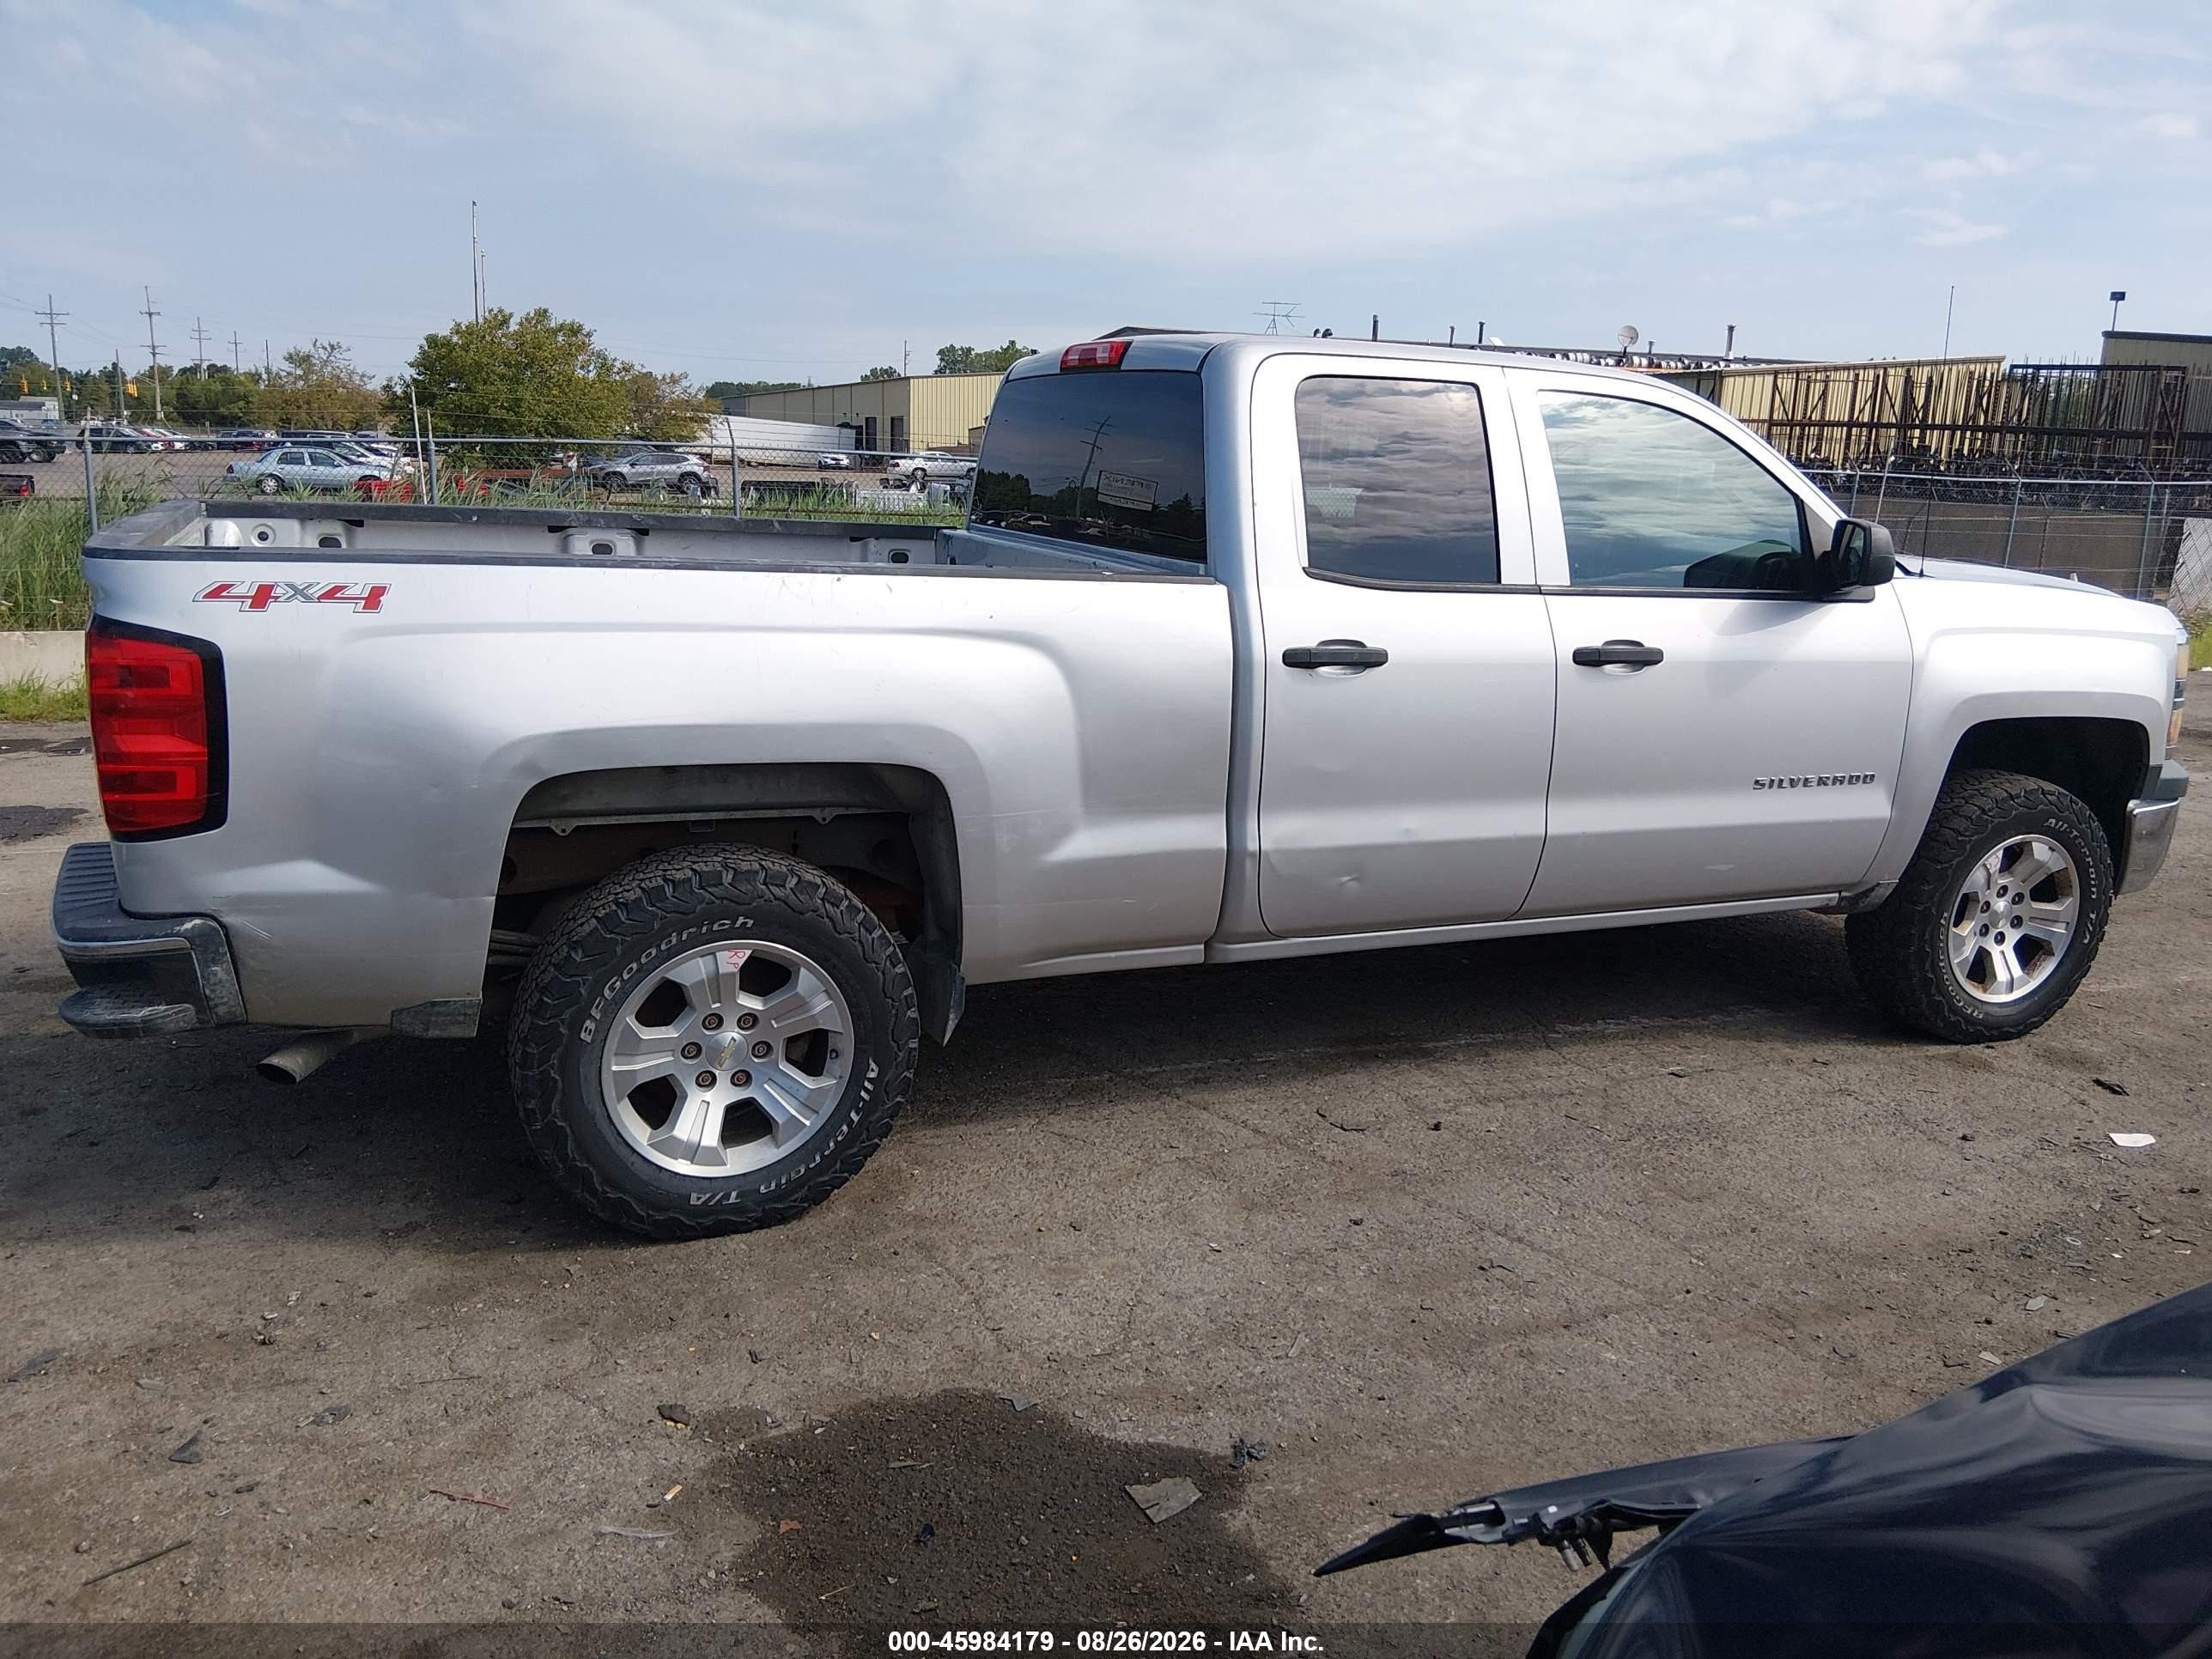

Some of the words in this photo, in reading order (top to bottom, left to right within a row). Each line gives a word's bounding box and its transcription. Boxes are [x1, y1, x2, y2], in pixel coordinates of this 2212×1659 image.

[1753, 773, 1875, 790] SILVERADO
[580, 916, 754, 1043] BFGoodrich
[760, 1058, 879, 1194] All-Terrain
[690, 1190, 741, 1206] T/A
